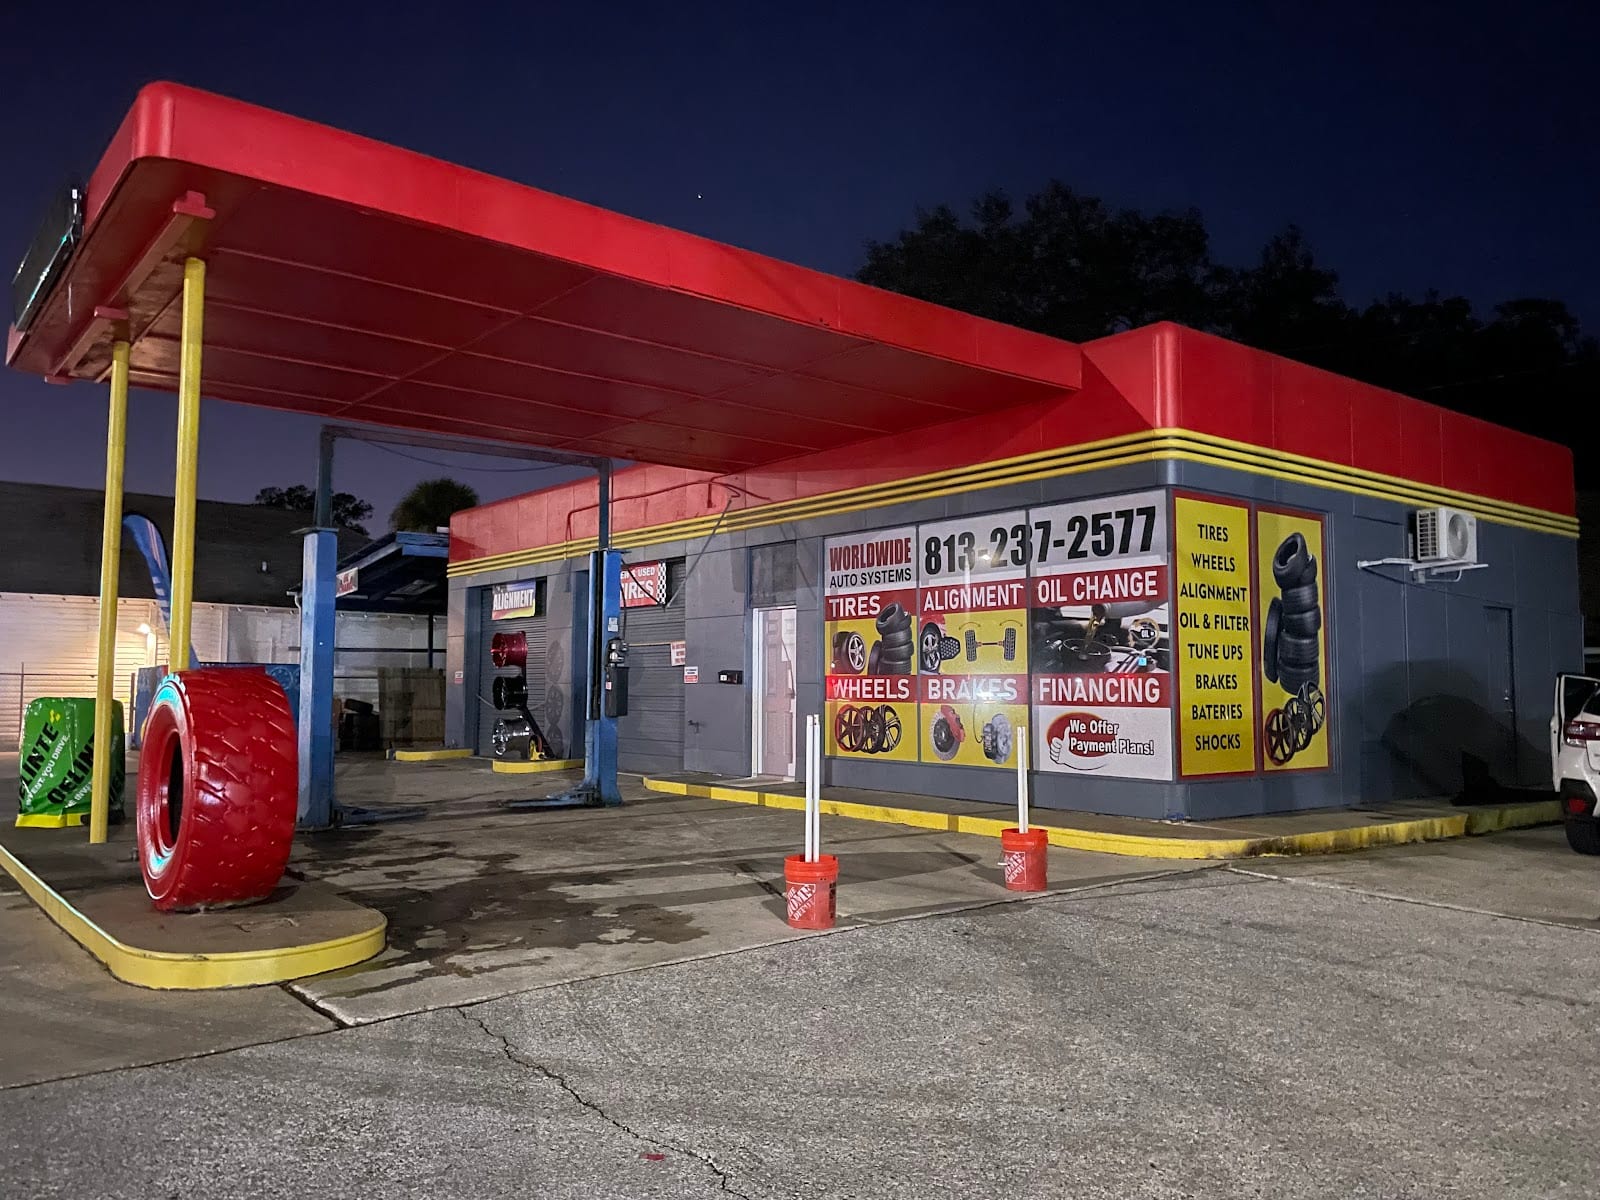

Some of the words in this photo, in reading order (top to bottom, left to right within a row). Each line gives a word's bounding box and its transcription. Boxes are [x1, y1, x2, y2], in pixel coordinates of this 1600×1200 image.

[924, 506, 1156, 575] 813-237-2577
[1197, 524, 1228, 542] TIRES
[829, 537, 912, 572] WORLDWIDE
[1191, 552, 1235, 572] WHEELS
[637, 566, 655, 577] USED
[829, 573, 858, 589] AUTO
[860, 568, 912, 585] SYSTEMS
[924, 582, 1023, 611] ALIGNMENT
[1037, 579, 1068, 603] OIL
[1073, 570, 1158, 601] CHANGE
[1180, 582, 1247, 602] ALIGNMENT
[493, 589, 533, 611] ALIGNMENT
[829, 595, 881, 618] TIRES
[1179, 612, 1199, 629] OIL
[1203, 614, 1211, 629] &
[1214, 613, 1249, 632] FILTER
[1187, 643, 1220, 660] TUNE
[1222, 644, 1243, 661] UPS
[832, 678, 910, 701] WHEELS
[928, 678, 1018, 701] BRAKES
[1038, 676, 1160, 704] FINANCING
[1195, 673, 1238, 691] BRAKES
[1191, 704, 1243, 721] BATERIES
[1069, 720, 1087, 734] We
[1089, 721, 1119, 736] Offer
[1069, 737, 1117, 755] Payment
[1118, 739, 1154, 756] Plans!
[1195, 734, 1241, 752] SHOCKS
[41, 759, 56, 778] YOU
